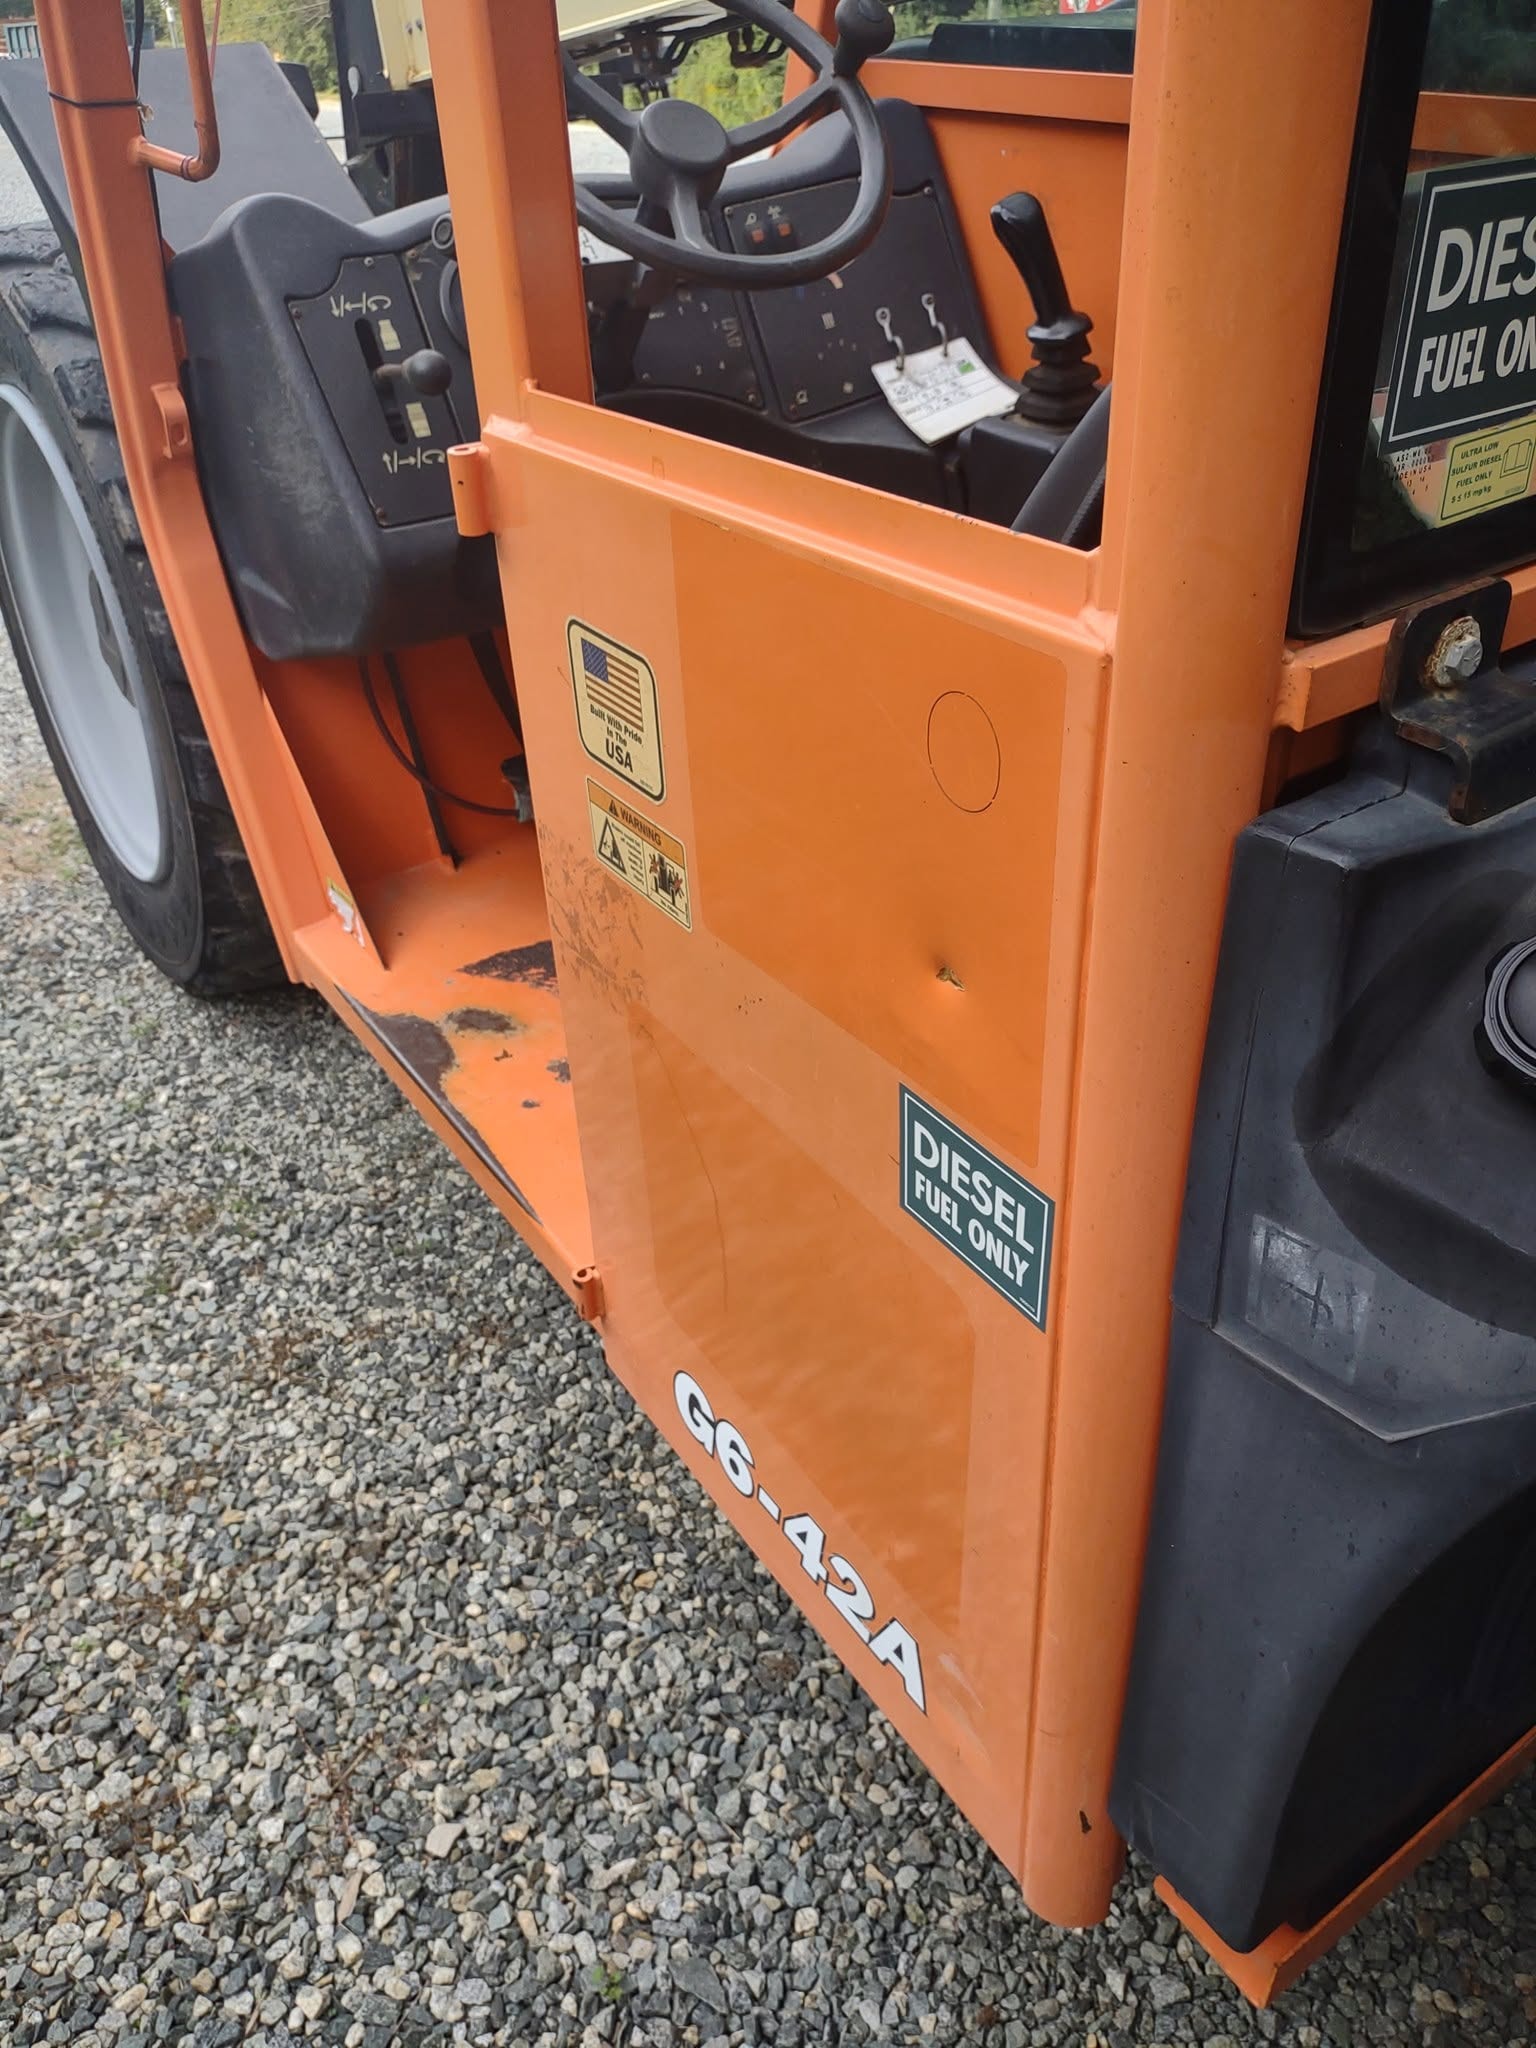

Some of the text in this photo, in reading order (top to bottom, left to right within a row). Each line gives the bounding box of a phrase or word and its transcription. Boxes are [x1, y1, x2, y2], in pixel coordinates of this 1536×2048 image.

[1413, 326, 1488, 398] FUEL
[1451, 460, 1480, 476] SULFUR
[1479, 454, 1502, 468] DIESEL
[1461, 441, 1500, 459] ULTRA LOW
[1456, 470, 1493, 489] FUEL ONLY
[1463, 489, 1471, 500] 15
[590, 703, 642, 745] Built With Pride
[607, 726, 628, 747] In The
[605, 738, 633, 773] USA
[620, 807, 662, 847] WARNING
[913, 1119, 1035, 1255] DIESEL
[914, 1170, 1030, 1288] FUEL ONLY
[673, 1369, 928, 1717] G6-42A
